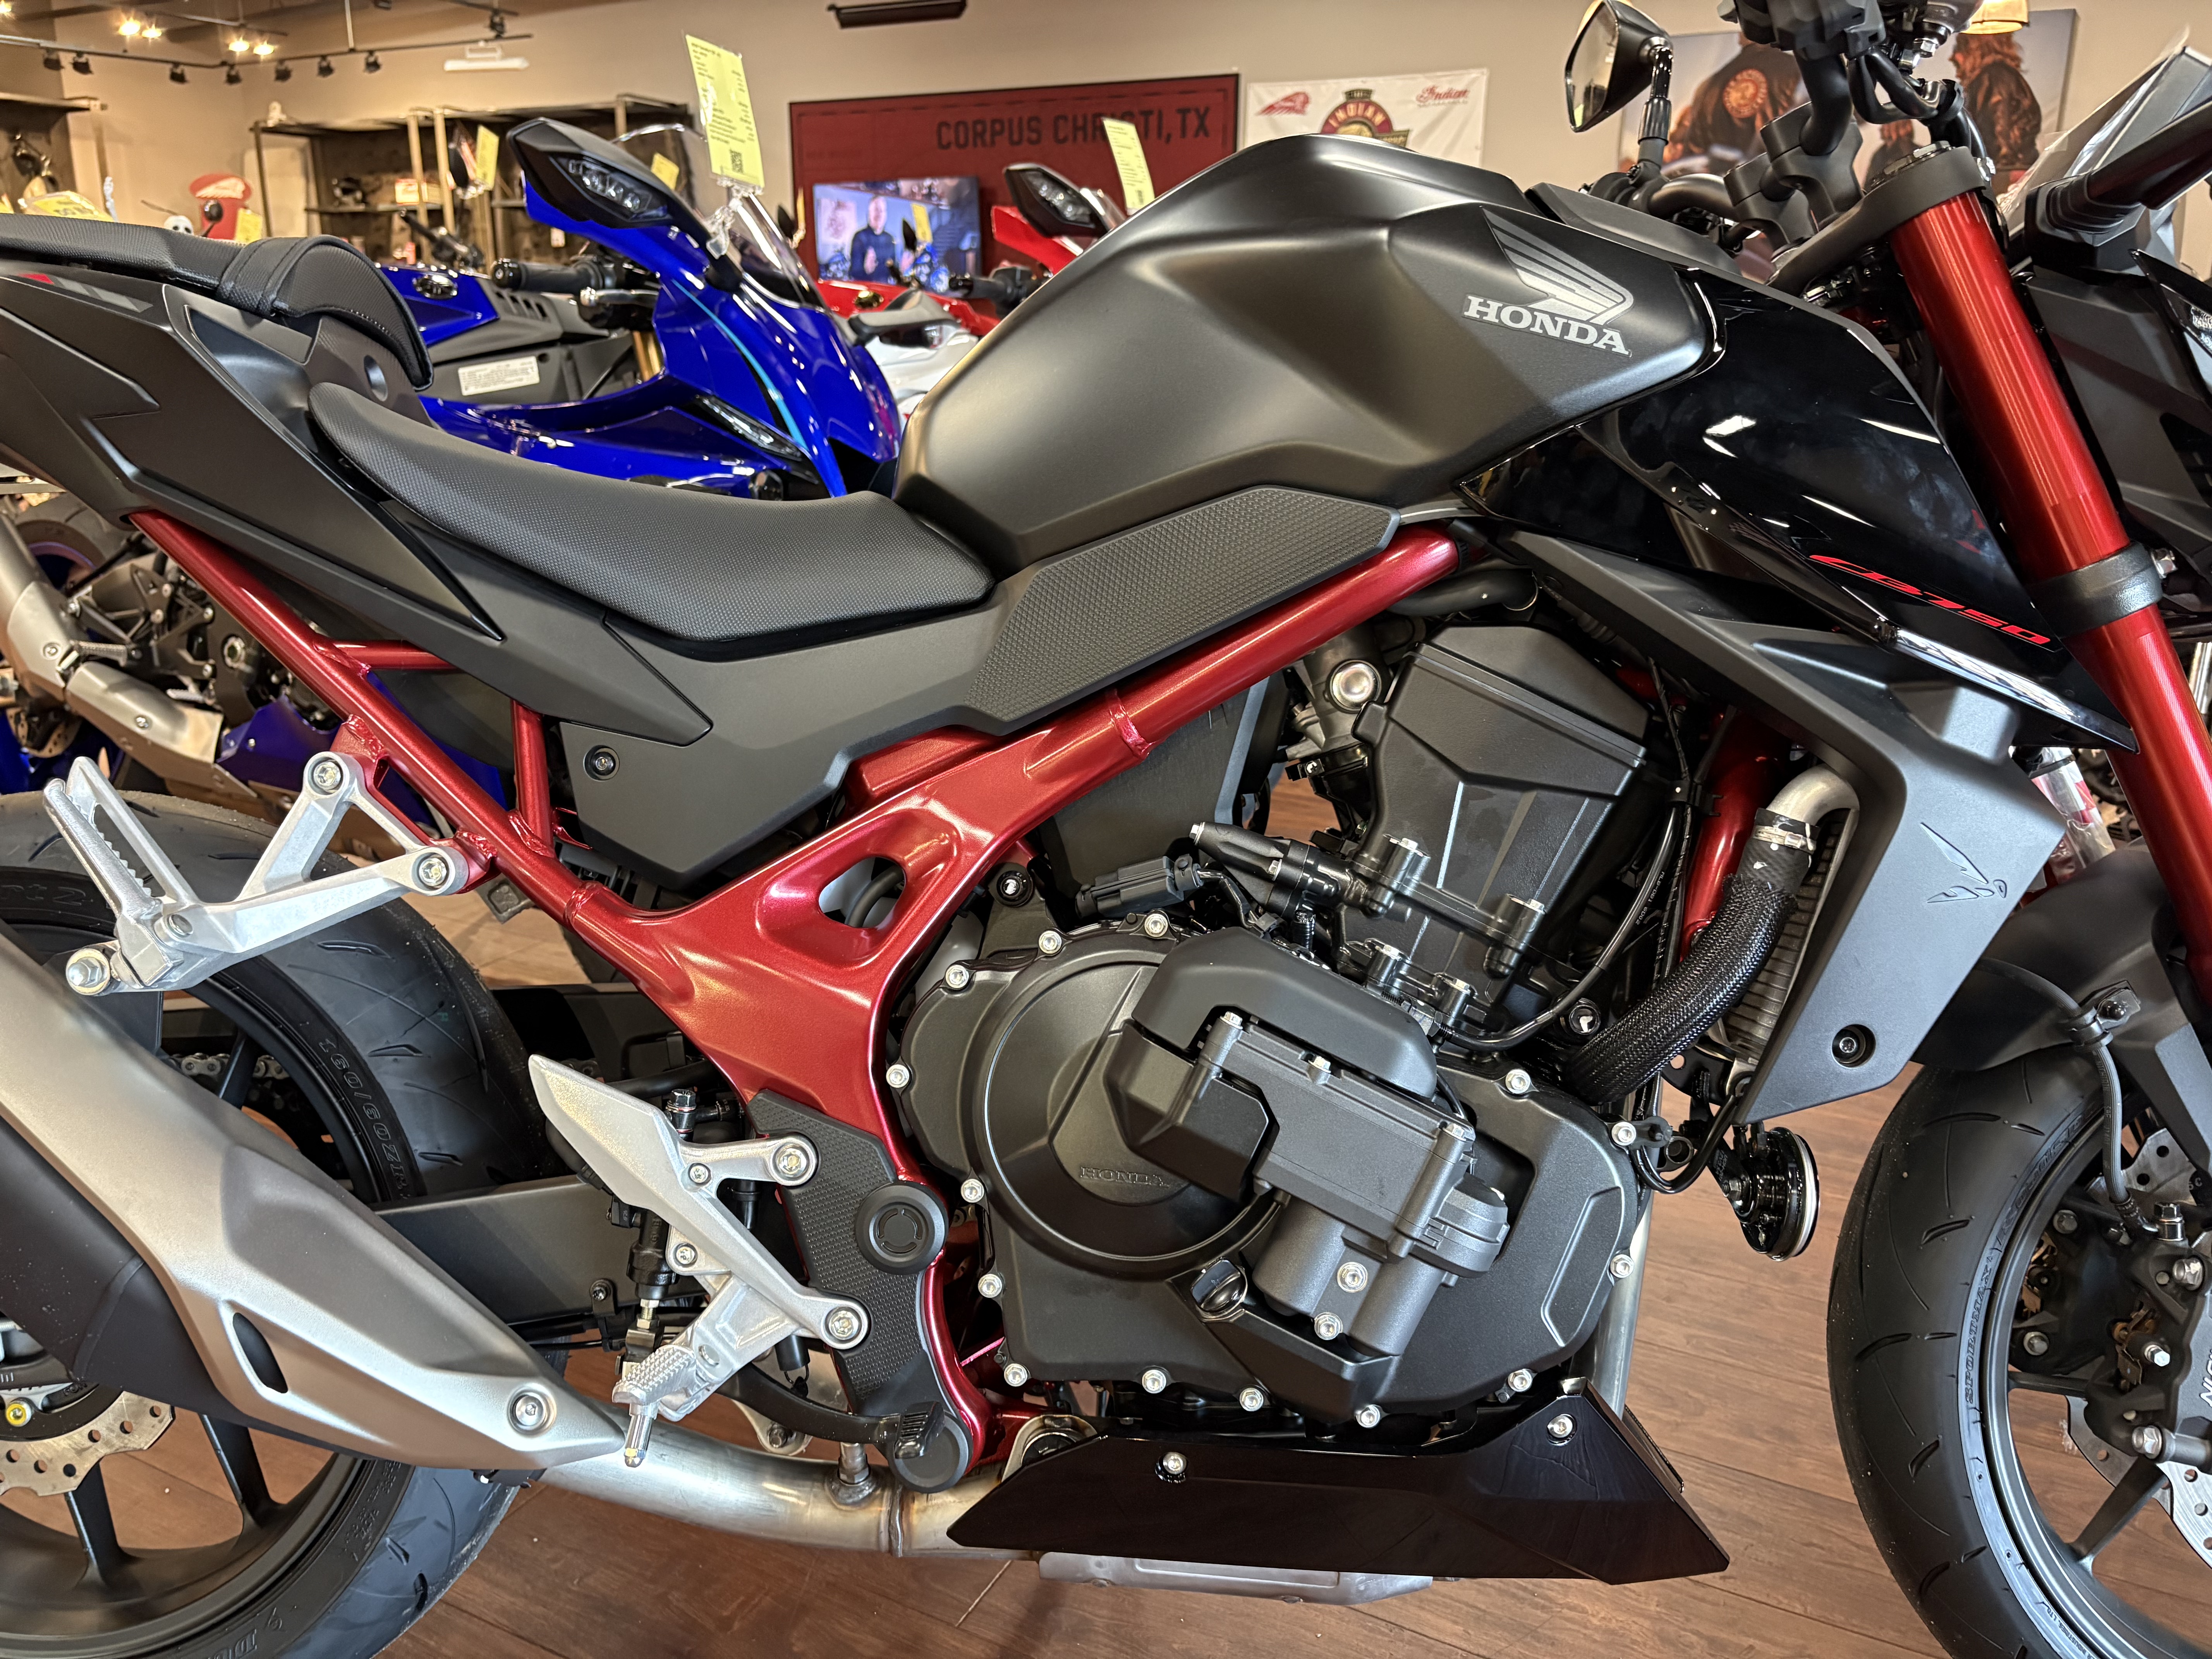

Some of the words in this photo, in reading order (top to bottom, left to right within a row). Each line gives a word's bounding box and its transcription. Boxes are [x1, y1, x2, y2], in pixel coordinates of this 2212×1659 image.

[936, 117, 1042, 149] CORPUS
[1053, 109, 1172, 144] CHRTI,
[1176, 106, 1210, 139] TX
[1329, 102, 1386, 128] INDIAN
[1463, 295, 1632, 357] HONDA
[1810, 555, 2051, 644] CB750
[1080, 1166, 1170, 1188] HONDA
[1963, 1265, 1992, 1404] SPORTMAX
